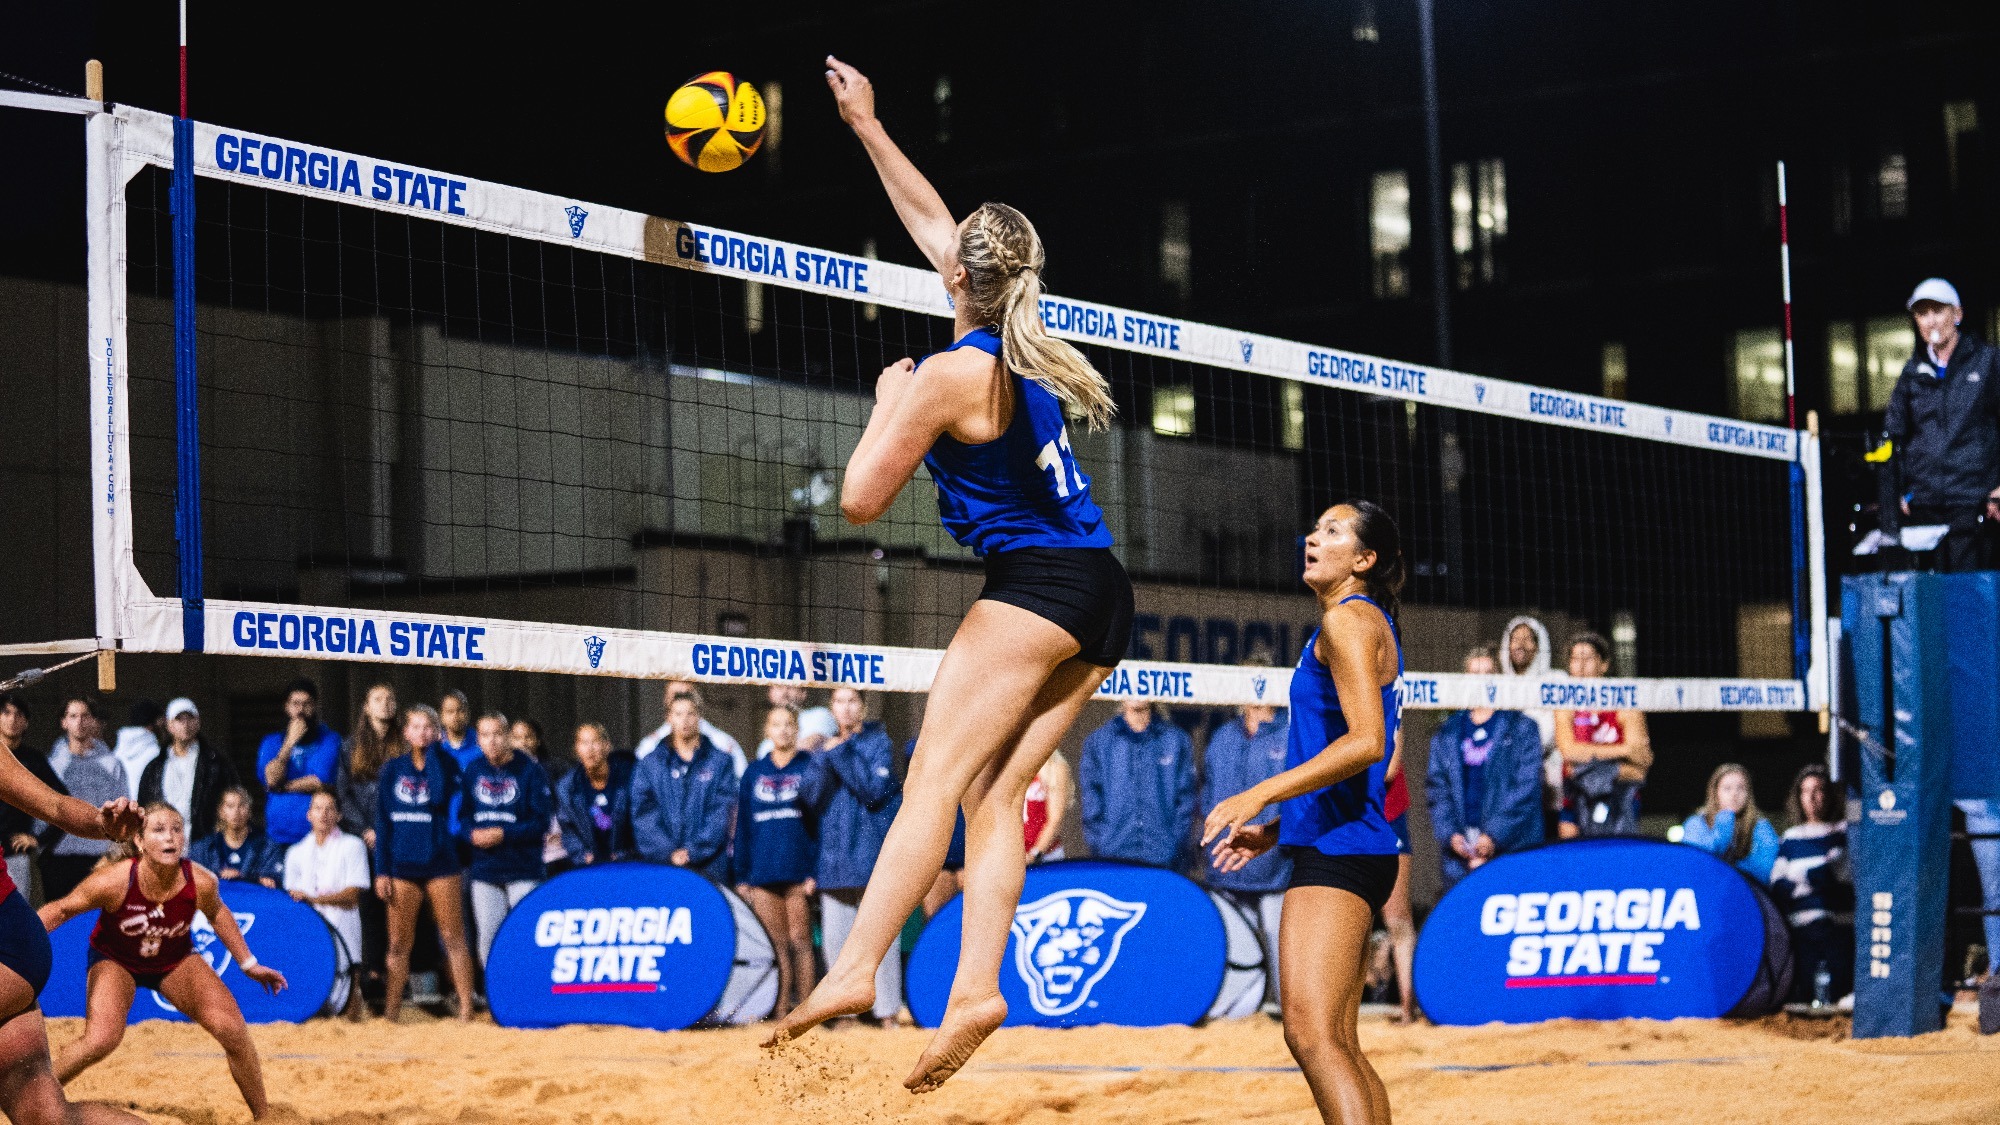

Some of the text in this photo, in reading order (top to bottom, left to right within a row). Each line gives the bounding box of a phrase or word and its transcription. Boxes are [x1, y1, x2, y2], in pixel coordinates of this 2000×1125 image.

[215, 133, 467, 216] GEORGIA STATE
[676, 227, 868, 293] GEORGIA STATE
[1038, 299, 1180, 350] GEORGIA STATE
[1308, 351, 1426, 394] GEORGIA STATE
[1530, 391, 1626, 428] GEORGIA STATE
[233, 611, 486, 661] GEORGIA STATE
[692, 643, 885, 685] GEORGIA STATE
[1096, 668, 1194, 698] GIA STATE
[1404, 680, 1439, 703] TATE
[1541, 683, 1637, 707] GEORGIA STATE
[534, 906, 693, 947] GEORGIA
[1480, 888, 1701, 936] GEORGIA
[551, 944, 666, 983] STATE
[1506, 932, 1665, 977] STATE
